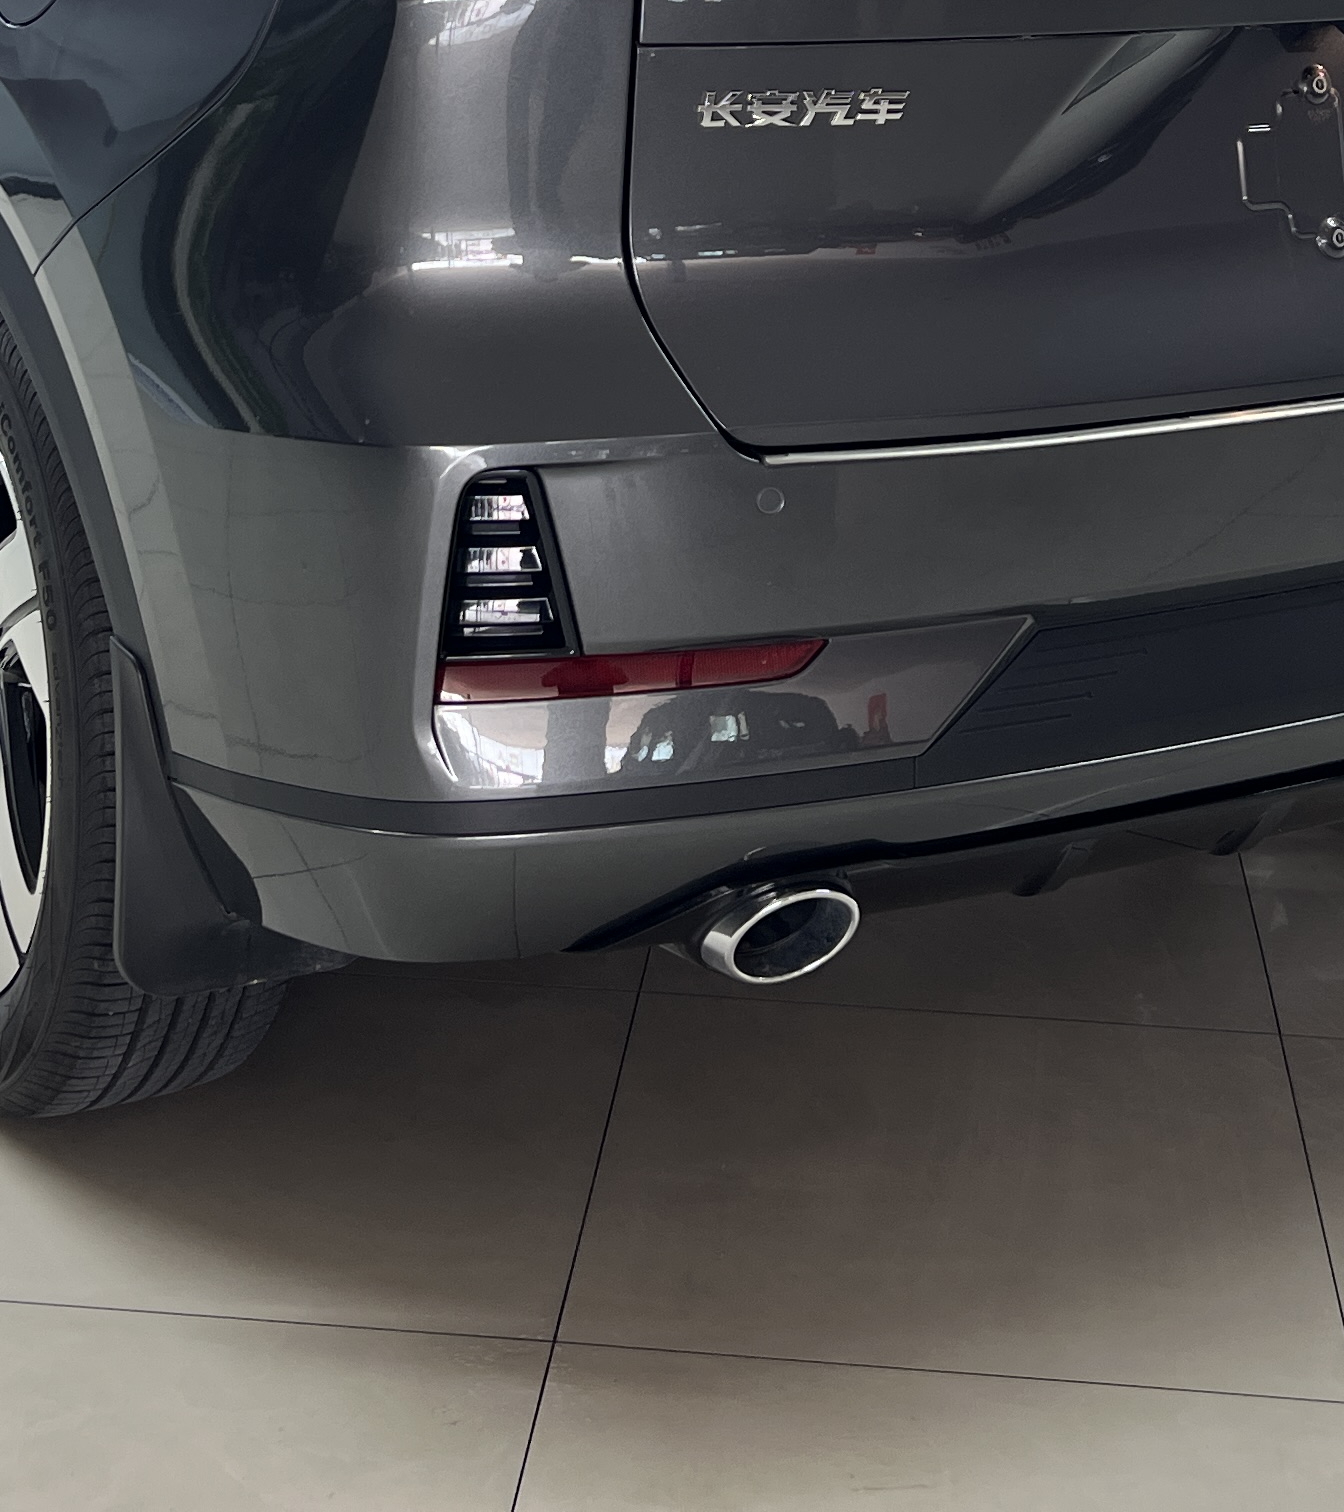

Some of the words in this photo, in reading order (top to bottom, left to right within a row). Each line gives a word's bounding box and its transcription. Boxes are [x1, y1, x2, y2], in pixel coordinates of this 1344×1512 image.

[696, 87, 911, 128] 长安汽车
[38, 559, 58, 632] F50
